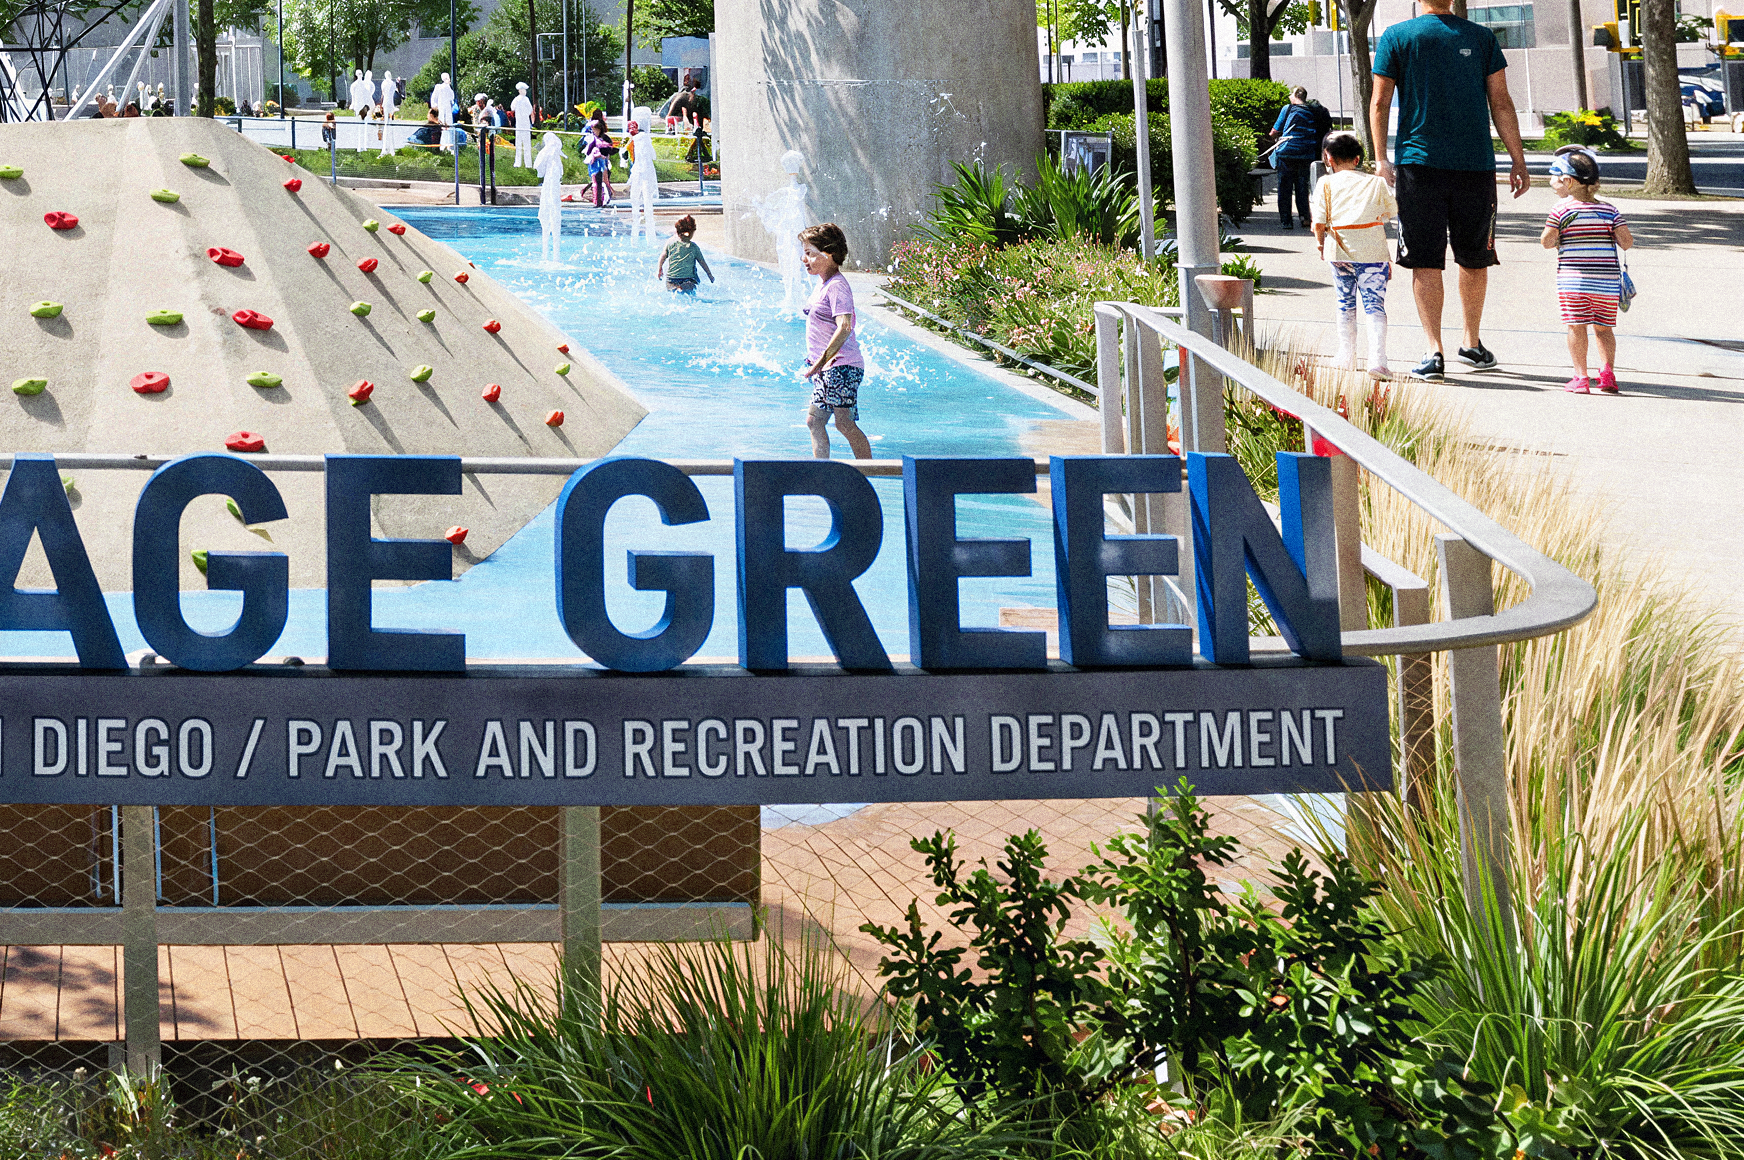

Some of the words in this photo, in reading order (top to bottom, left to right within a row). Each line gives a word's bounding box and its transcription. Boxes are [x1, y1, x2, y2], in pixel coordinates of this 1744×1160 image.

[554, 451, 1343, 672] GREEN
[33, 717, 213, 778] DIEGO
[236, 718, 265, 778] /
[287, 719, 448, 778] PARK
[475, 720, 598, 778] AND
[623, 716, 966, 778] RECREATION
[990, 708, 1344, 772] DEPARTMENT
